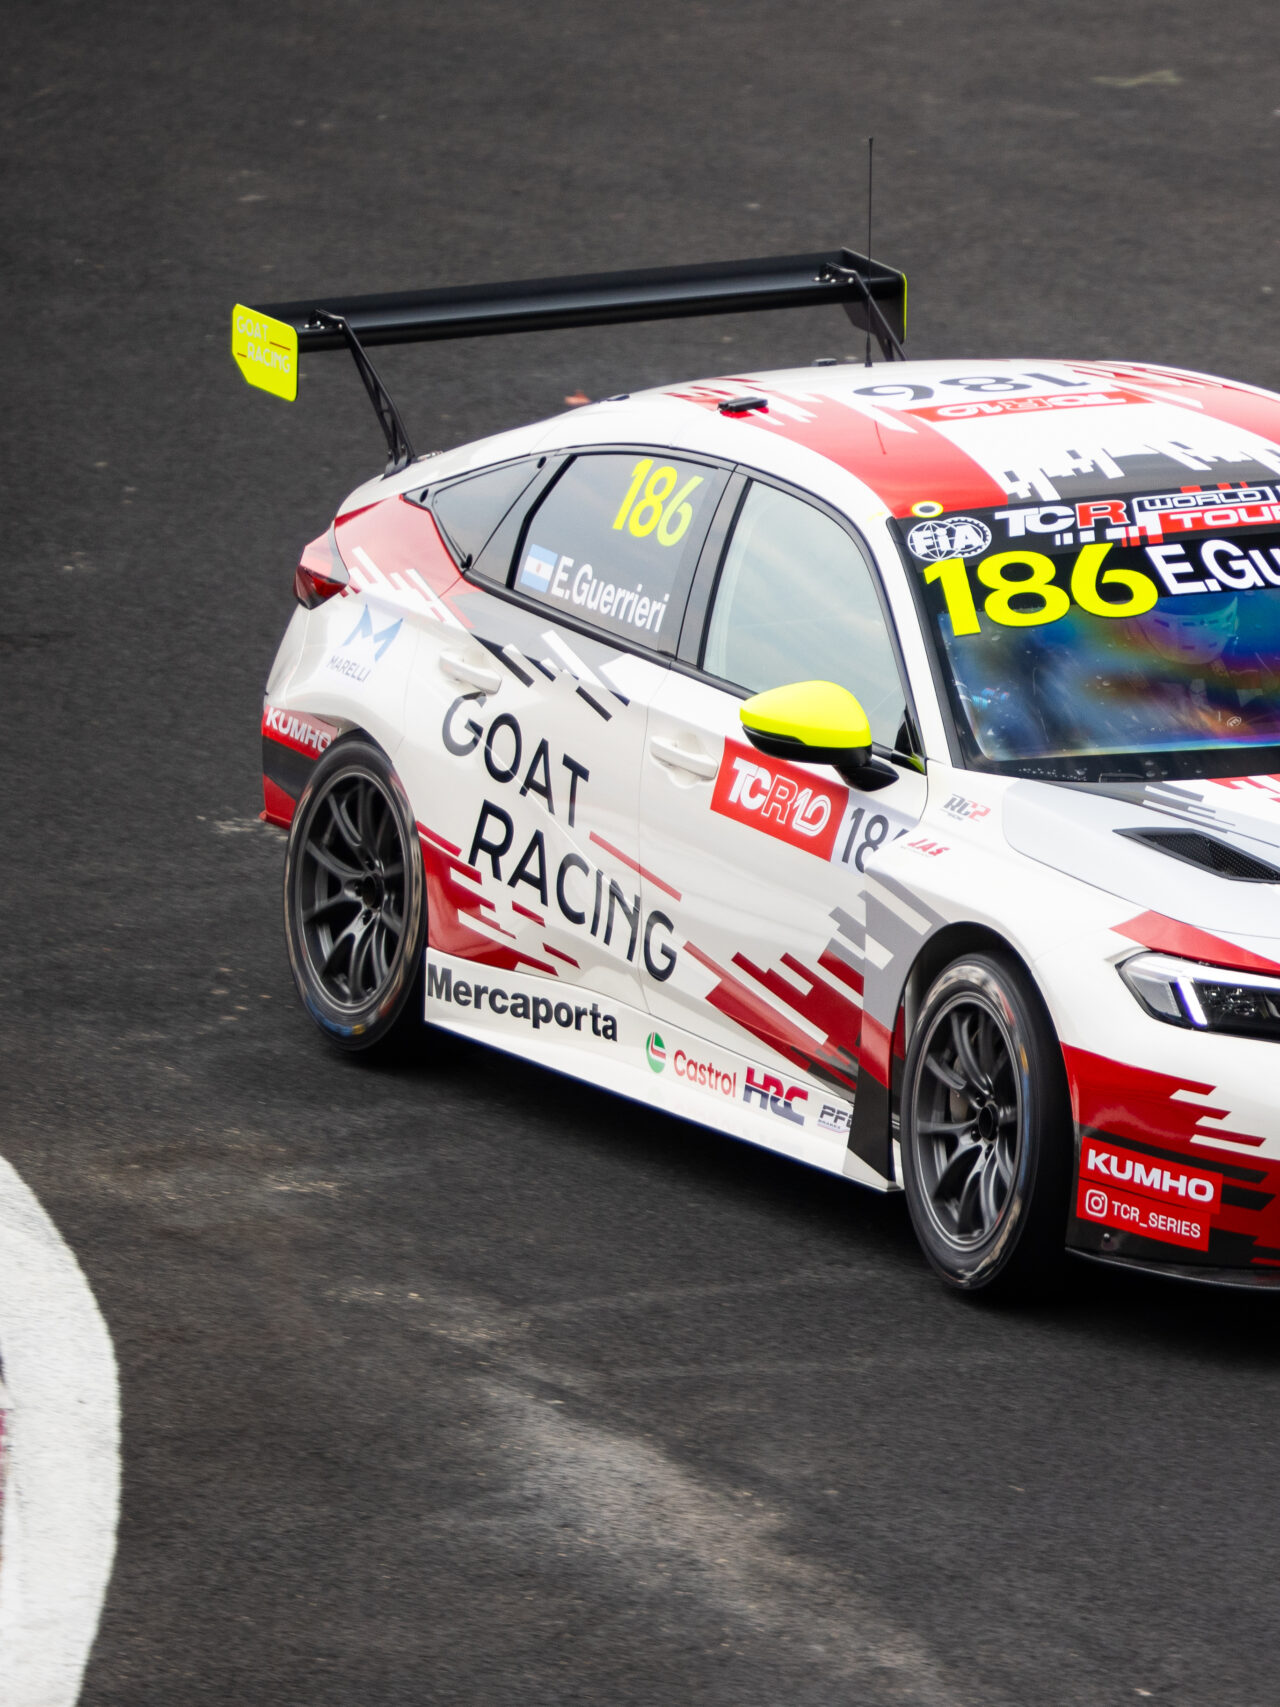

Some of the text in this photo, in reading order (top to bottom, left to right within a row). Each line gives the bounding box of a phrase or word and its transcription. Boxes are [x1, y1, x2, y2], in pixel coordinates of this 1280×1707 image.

[237, 315, 268, 342] GOAT
[247, 341, 291, 374] RACING
[612, 458, 704, 547] 186
[994, 489, 1262, 538] TCR WORLD
[551, 555, 670, 633] E.Guerrieri
[923, 542, 1159, 637] 186
[326, 655, 371, 683] MARELLI
[265, 706, 332, 753] KUMHO
[442, 690, 590, 827] GOAT
[841, 807, 909, 873] 18
[468, 799, 678, 982] RACING
[427, 963, 618, 1042] Mercaporta
[673, 1050, 737, 1098] Castrol
[743, 1066, 809, 1126] HRC
[1087, 1148, 1215, 1202] KUMHO
[1111, 1200, 1201, 1238] TCR_SERIES
